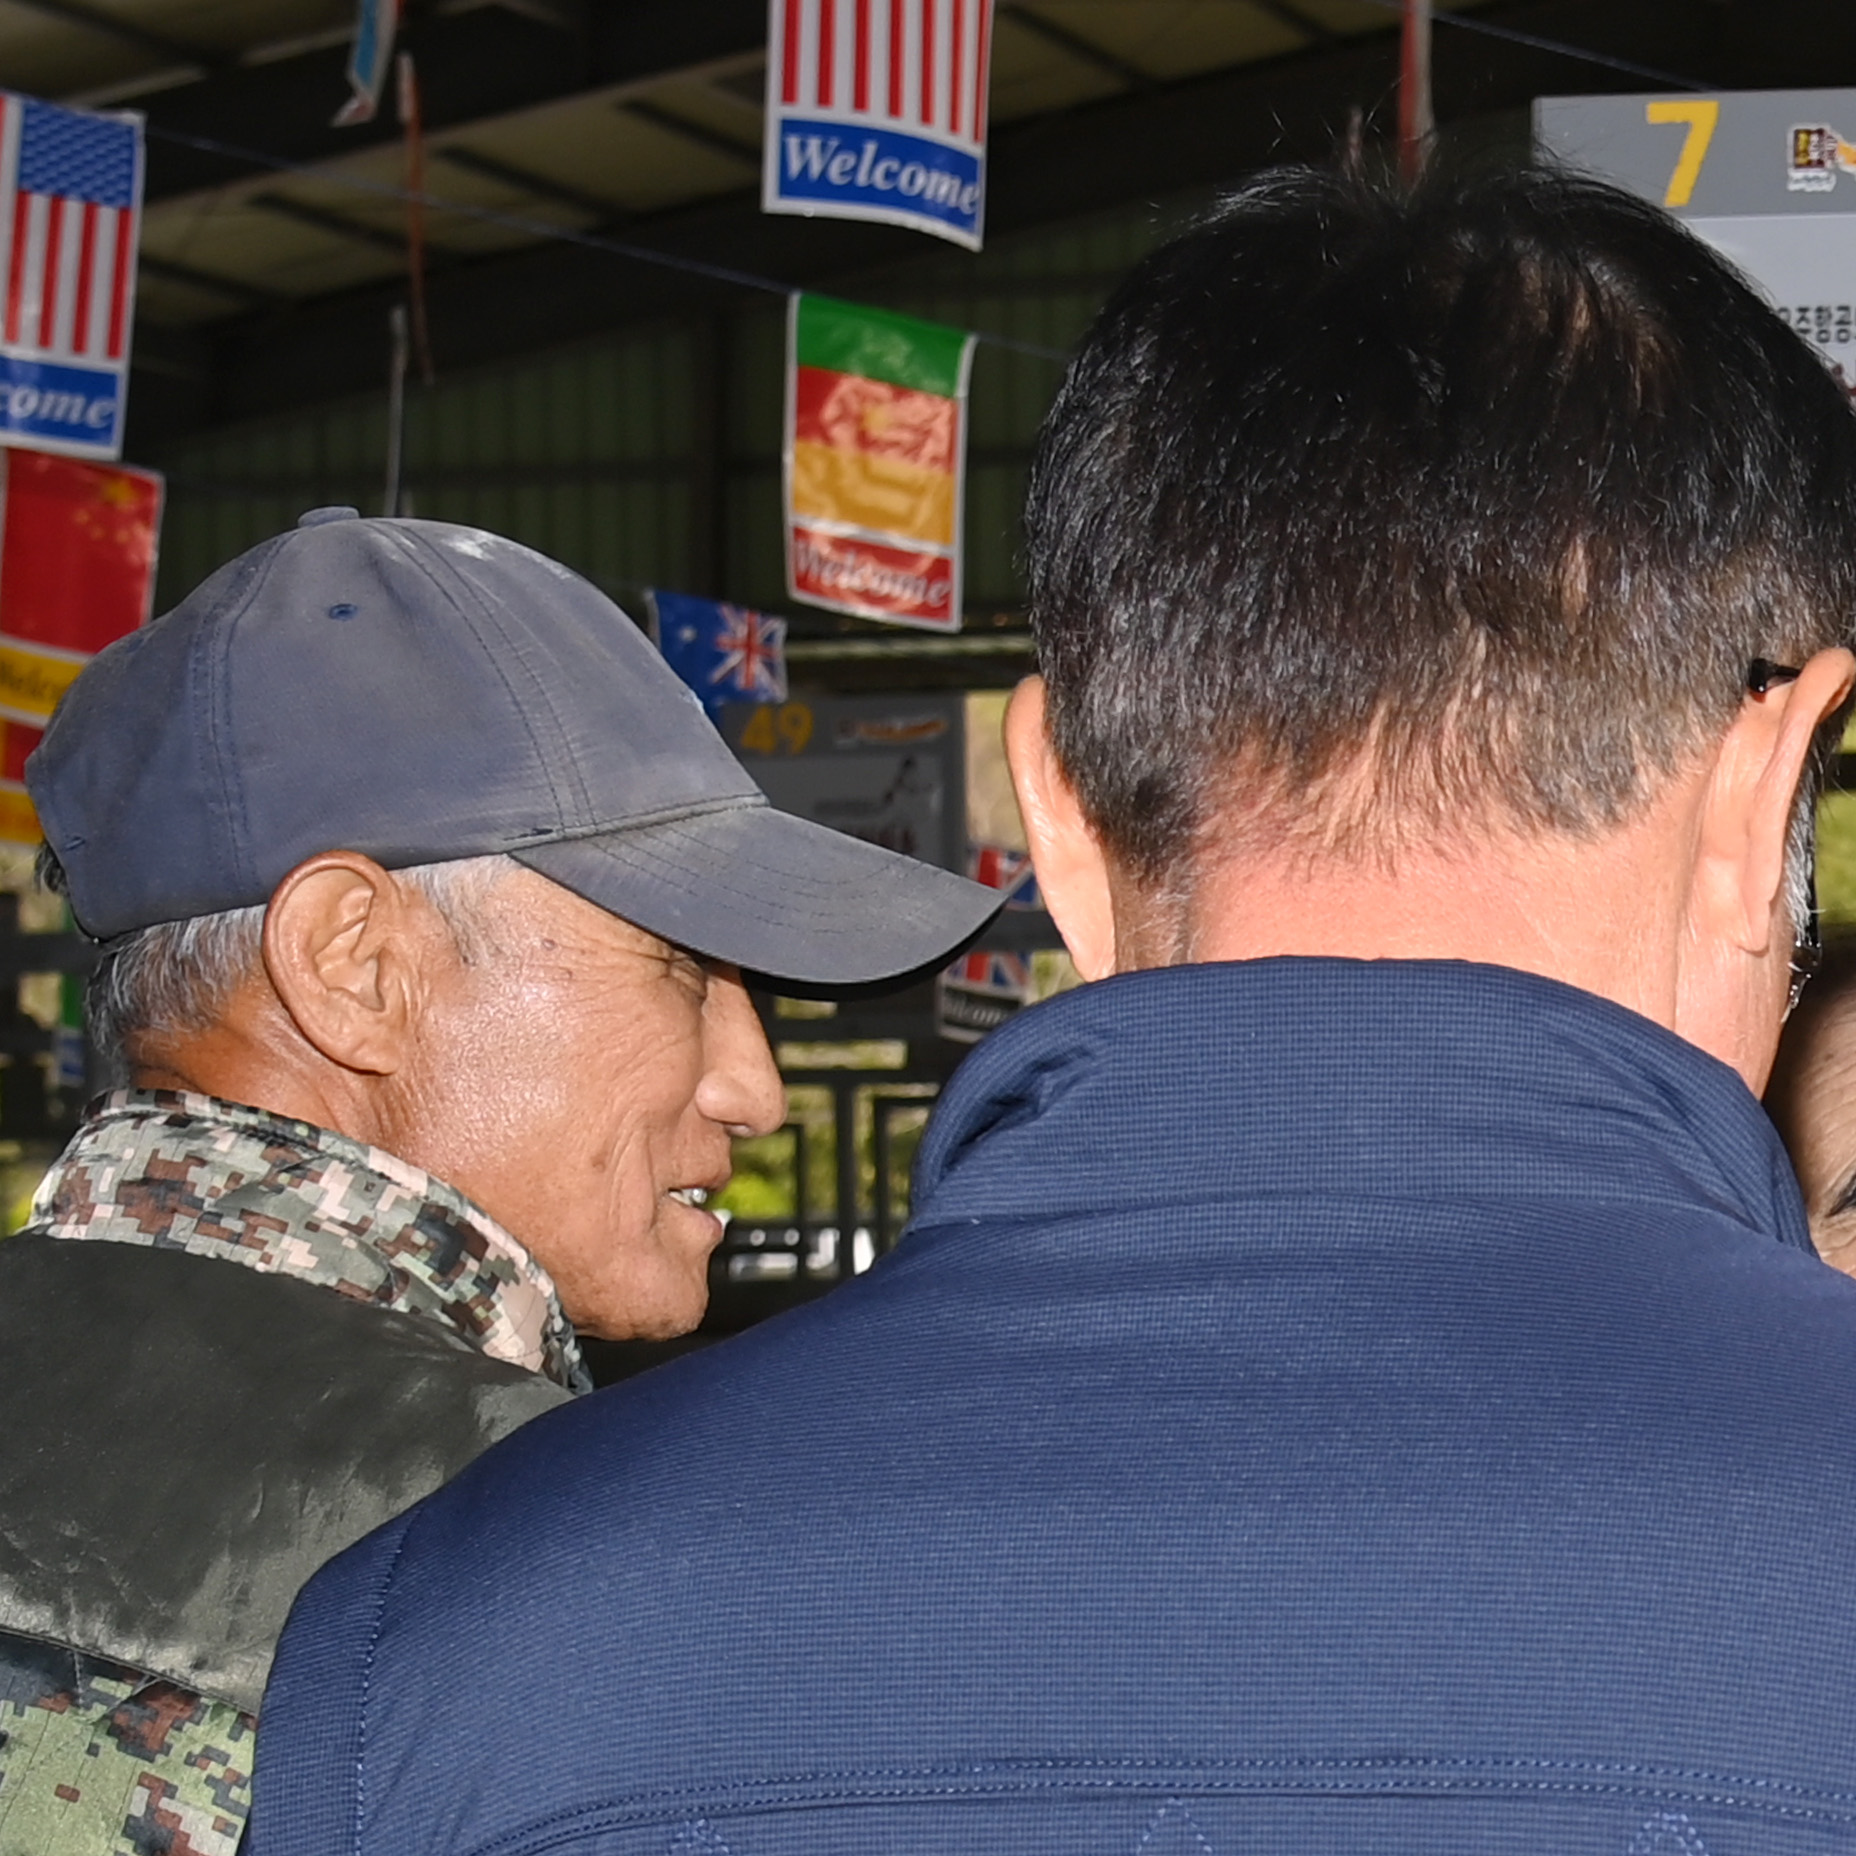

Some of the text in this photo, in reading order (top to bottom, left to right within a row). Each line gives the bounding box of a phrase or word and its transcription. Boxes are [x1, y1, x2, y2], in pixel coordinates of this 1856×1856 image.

[785, 135, 980, 215] Welcome
[1645, 100, 1719, 208] 7
[741, 704, 814, 755] 49
